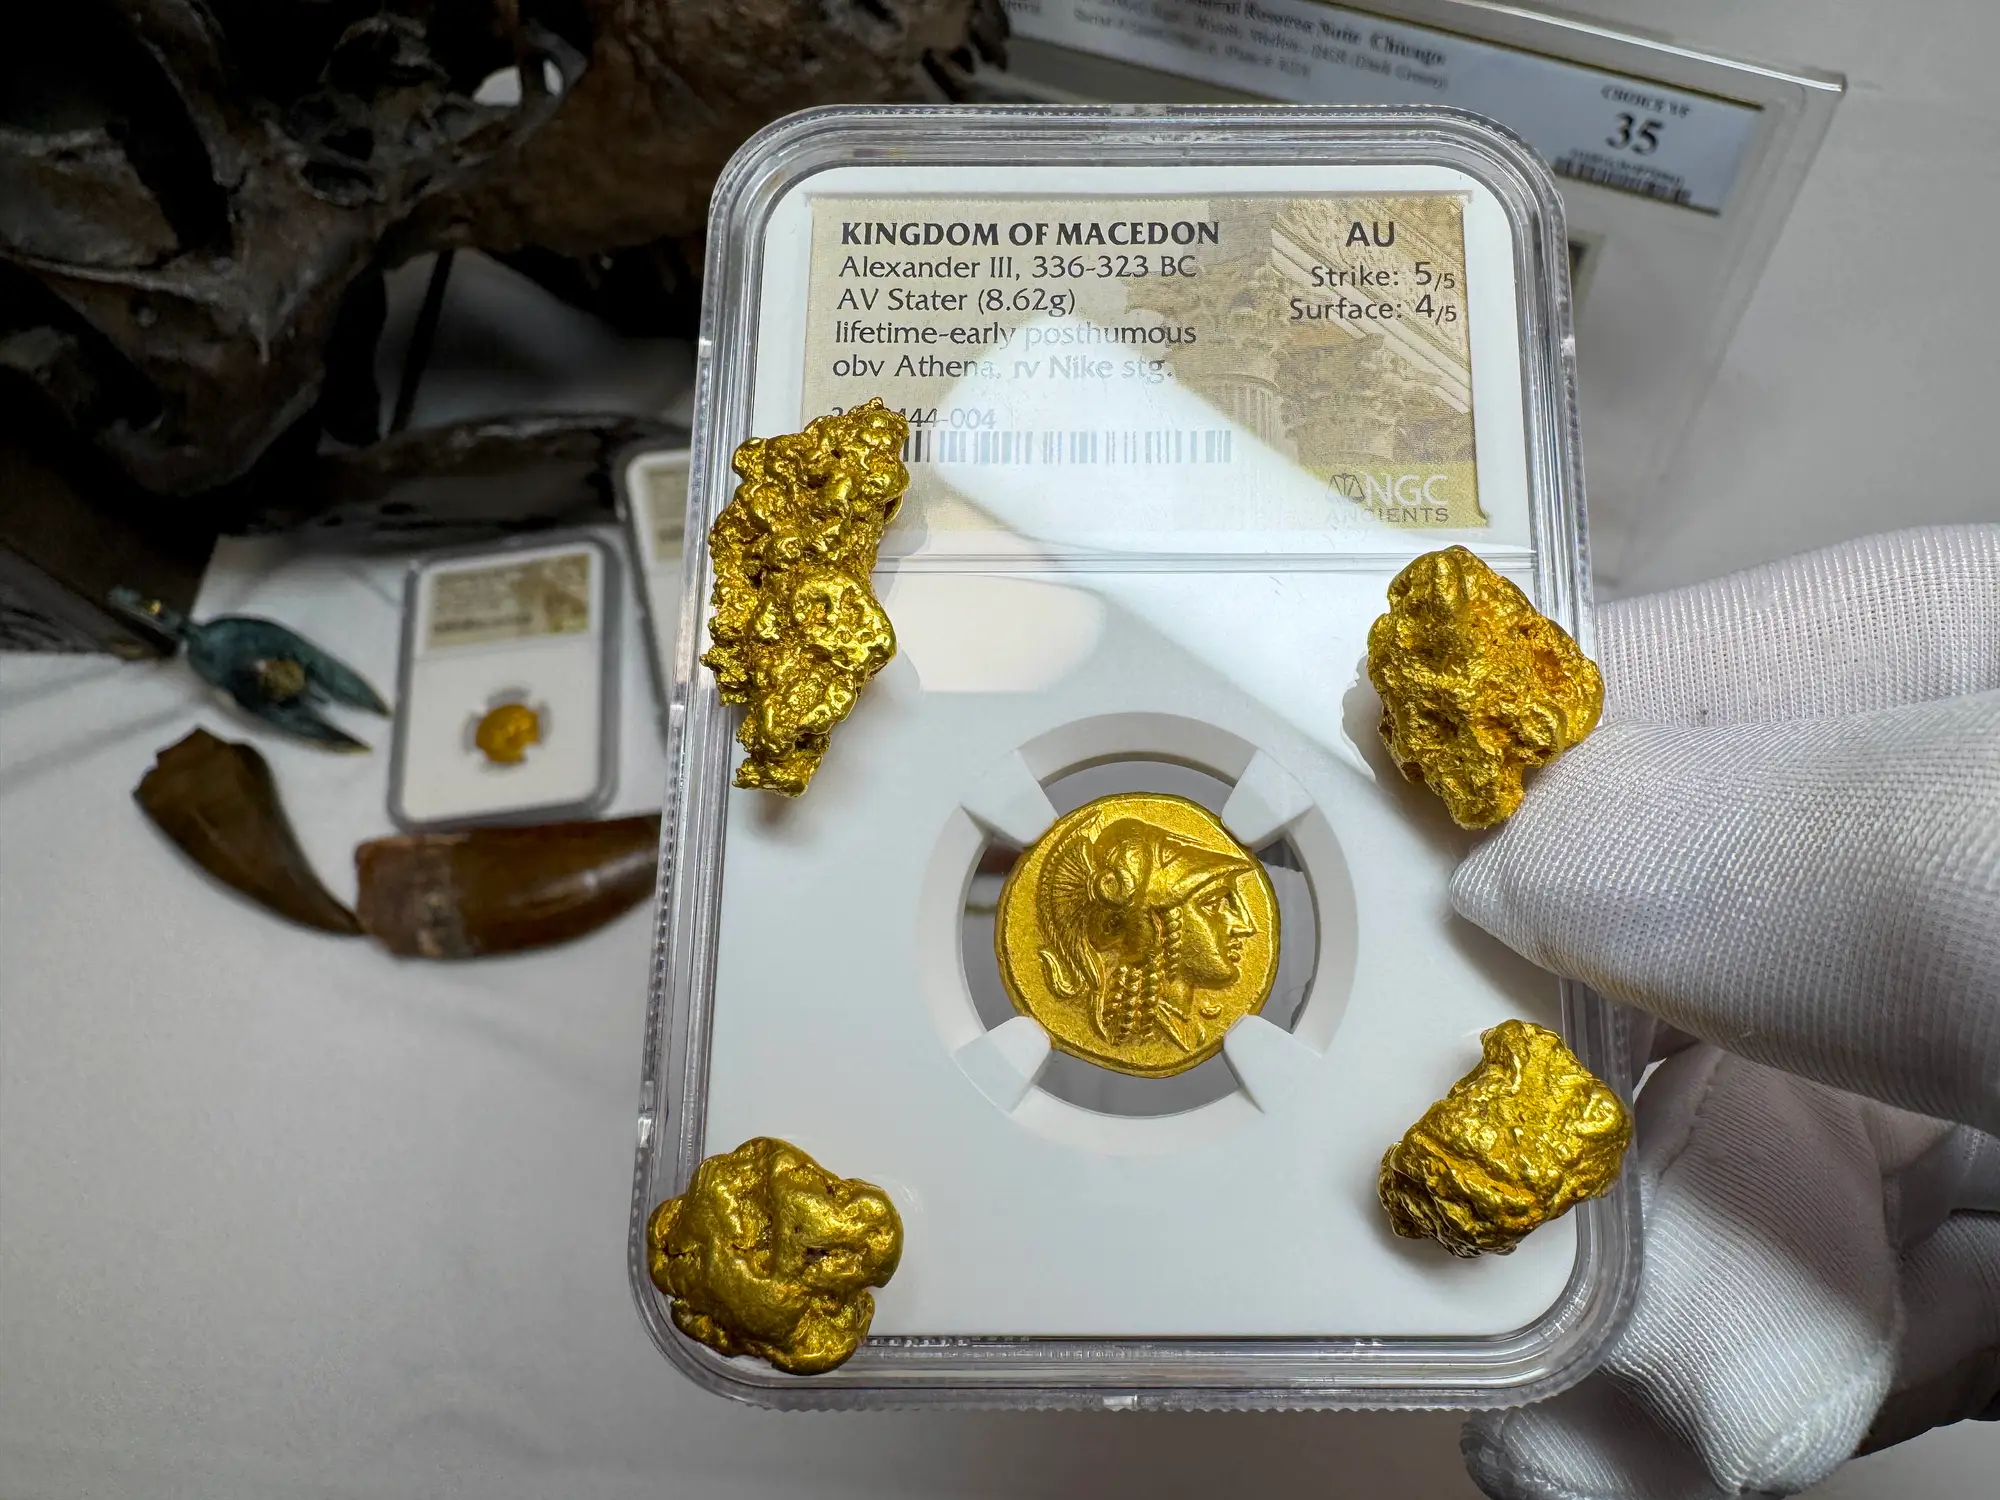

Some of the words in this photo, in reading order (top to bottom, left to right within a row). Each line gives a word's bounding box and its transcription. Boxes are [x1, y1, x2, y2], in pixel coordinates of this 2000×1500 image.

[1605, 111, 1665, 156] 35
[841, 222, 999, 246] KINGDOM
[1008, 222, 1049, 246] OF
[1056, 221, 1220, 246] MACEDON
[1345, 221, 1395, 248] AU
[838, 255, 981, 279] Alexander
[990, 256, 1021, 282] III,
[1031, 255, 1149, 279] 336-323
[1161, 254, 1198, 278] BC
[1311, 264, 1399, 288] Strike:
[1414, 261, 1456, 292] 5/5
[836, 287, 879, 311] AV
[887, 287, 968, 312] Stater
[978, 286, 1076, 318] (8.62g)
[1290, 297, 1402, 320] Surface:
[1415, 294, 1457, 326] 4/5
[835, 320, 1016, 350] lifetime-early
[1024, 320, 1197, 351] posthumous
[832, 353, 884, 378] obv
[894, 353, 1002, 379] Athena,
[1013, 359, 1041, 379] rv
[1049, 355, 1114, 379] Nike
[1121, 355, 1174, 384] stg.
[1365, 472, 1449, 507] NGC
[1326, 507, 1449, 523] ANCIENTS
